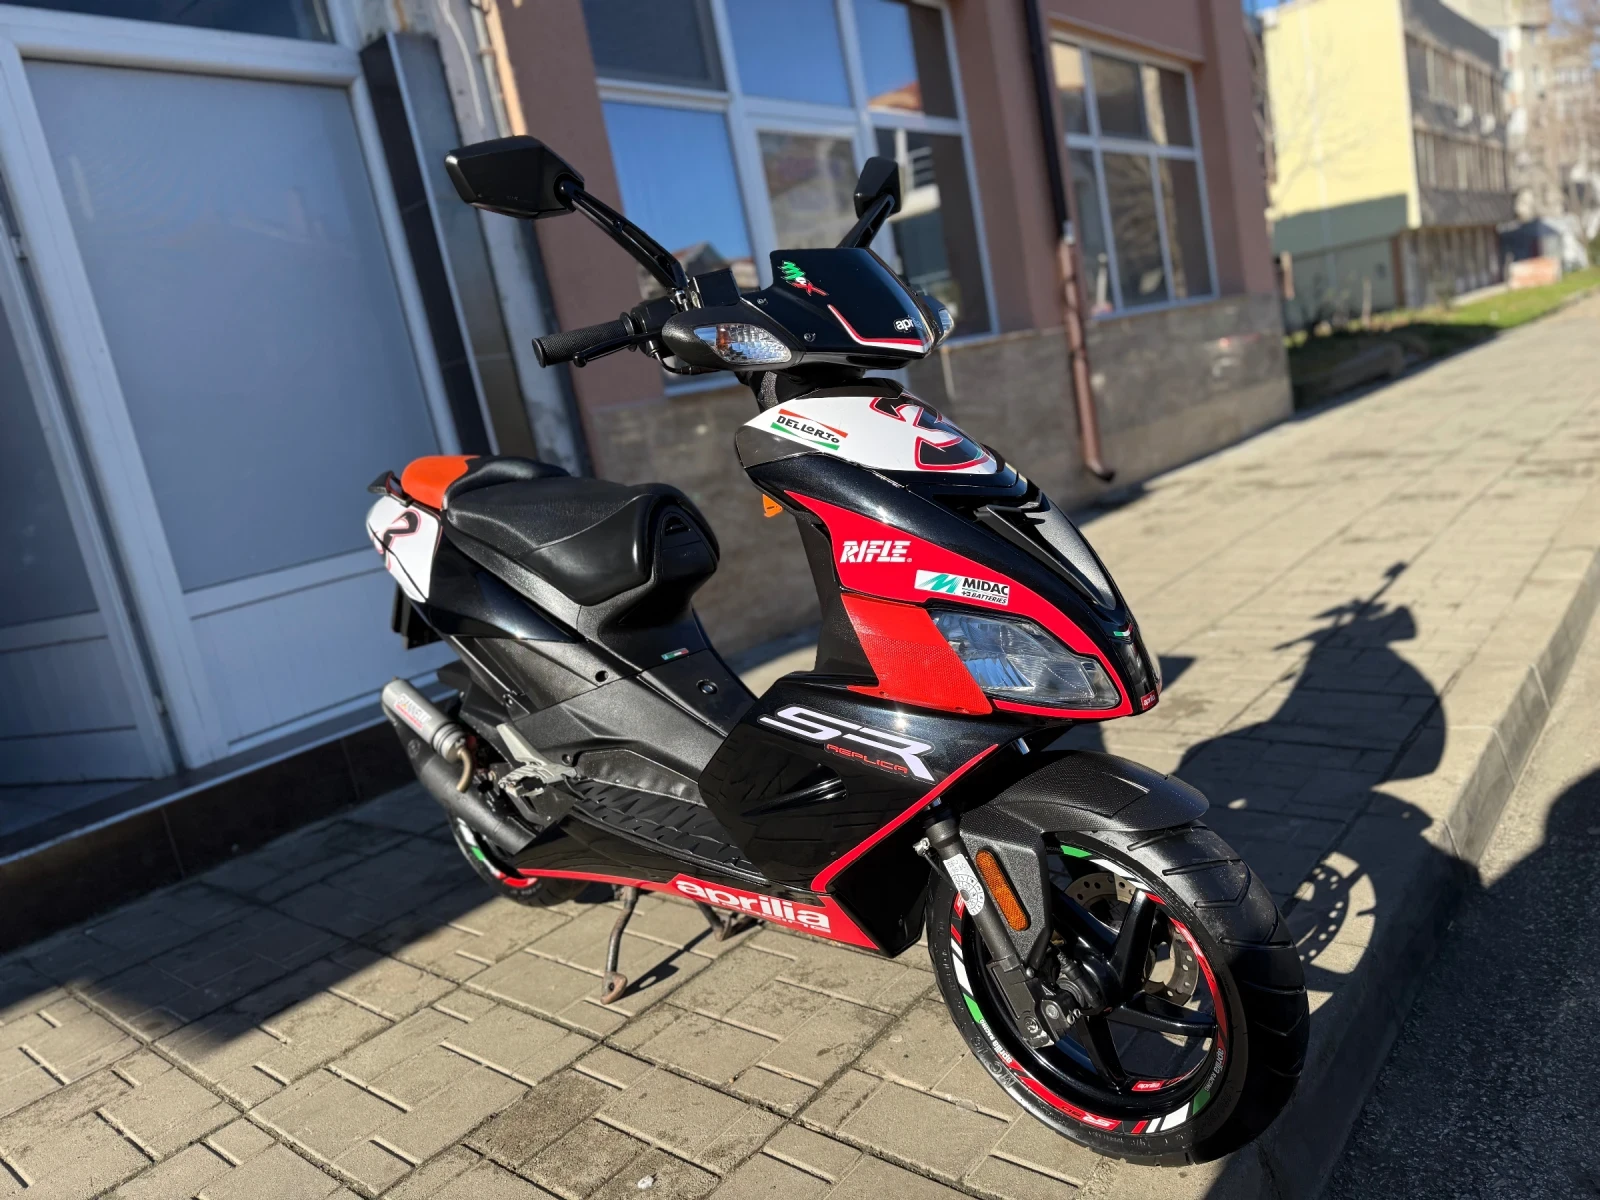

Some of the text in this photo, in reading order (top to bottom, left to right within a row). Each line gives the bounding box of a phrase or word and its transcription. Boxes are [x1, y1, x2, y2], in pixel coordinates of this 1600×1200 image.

[840, 540, 911, 563] RIFLE
[962, 577, 1009, 596] MIDAC
[971, 593, 1007, 604] BATTERIES
[759, 706, 935, 782] SR
[826, 743, 908, 774] REPLICA
[675, 879, 830, 928] aprilia
[979, 1018, 1012, 1064] aprilia RACING
[1213, 1048, 1224, 1074] aprilia
